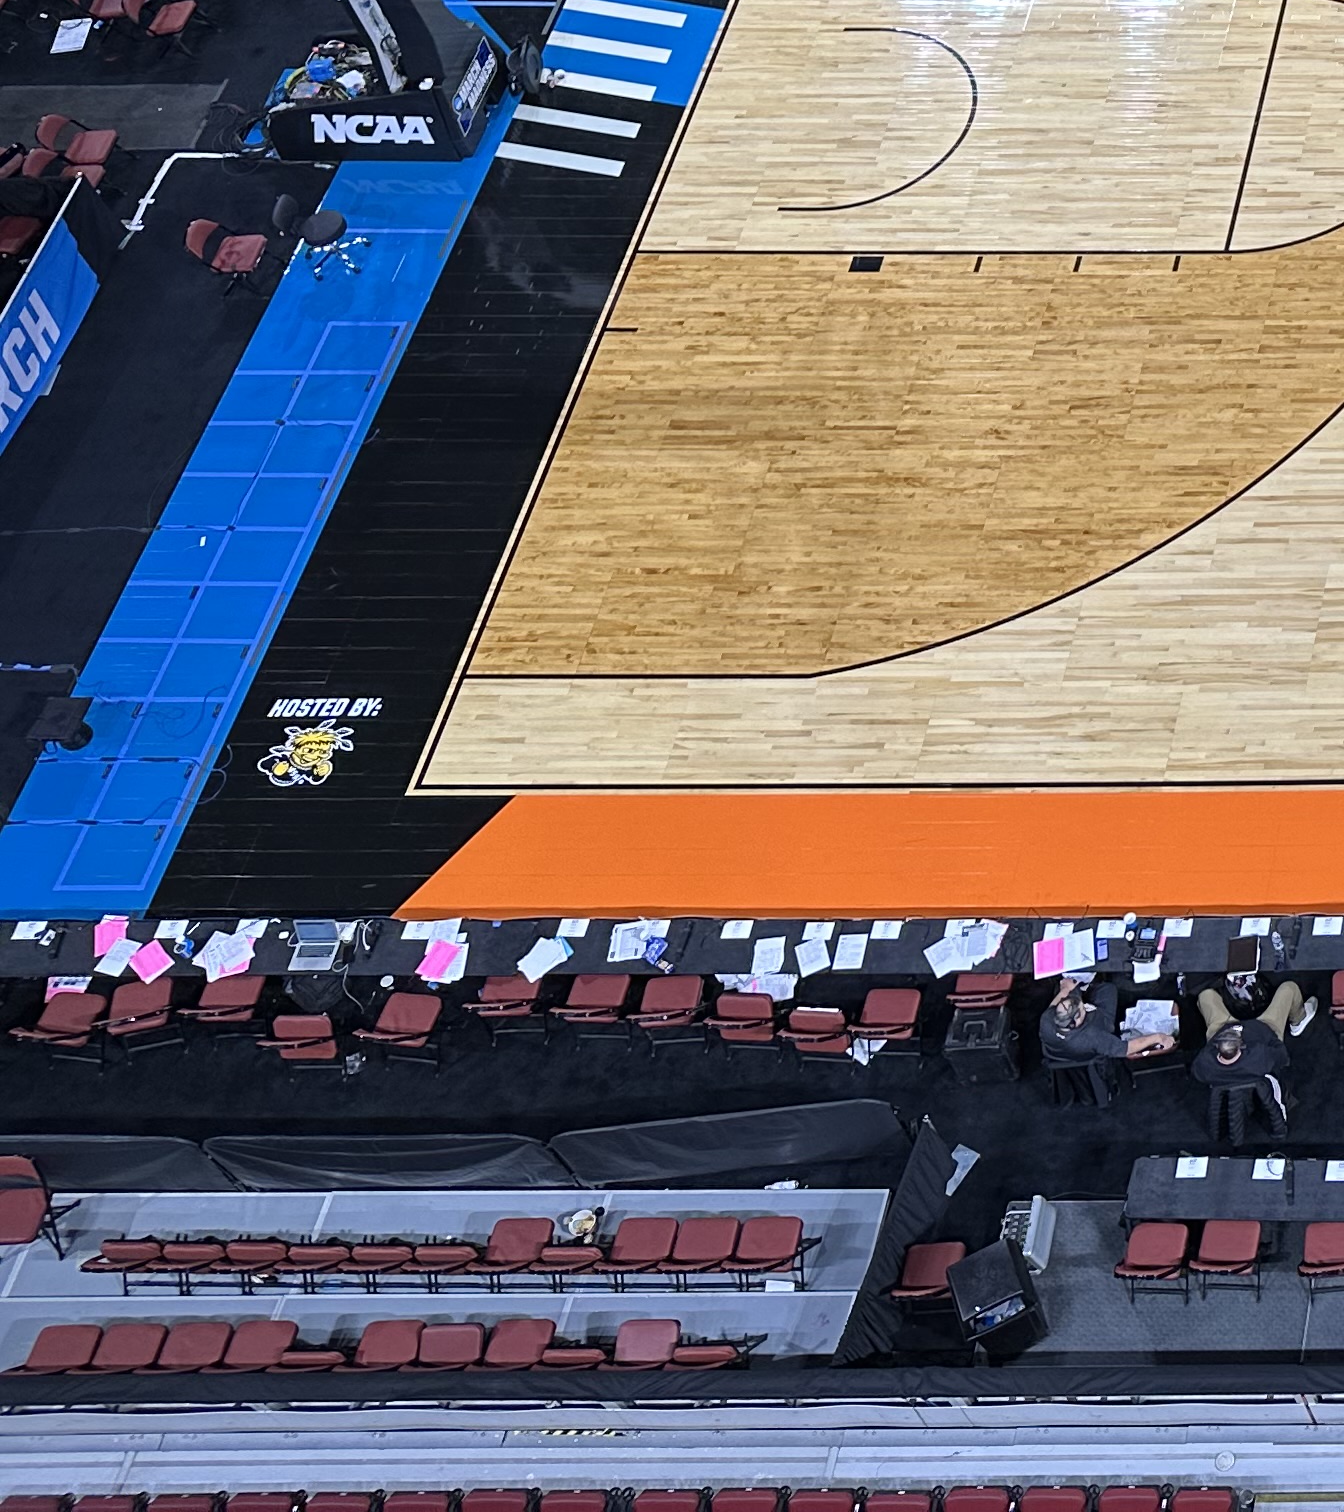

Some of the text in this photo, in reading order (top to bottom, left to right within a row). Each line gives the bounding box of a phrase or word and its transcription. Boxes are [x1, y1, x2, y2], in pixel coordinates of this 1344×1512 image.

[311, 114, 435, 144] NCAA
[267, 697, 383, 718] HOSTED BY:
